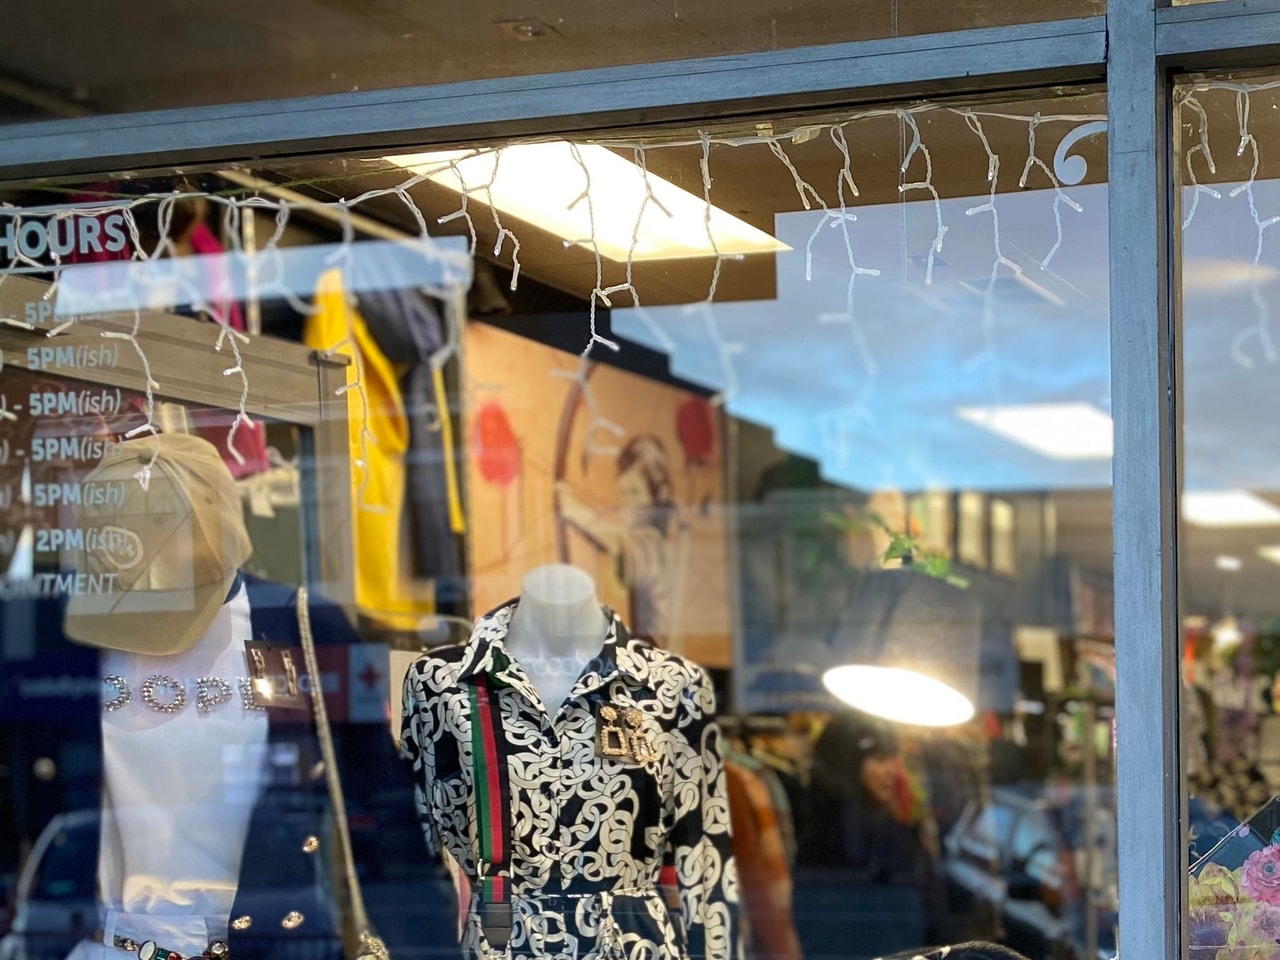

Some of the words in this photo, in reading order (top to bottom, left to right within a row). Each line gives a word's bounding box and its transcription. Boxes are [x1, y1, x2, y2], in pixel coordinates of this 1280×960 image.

[0, 214, 126, 259] HOURS
[27, 343, 119, 370] 5PM(ish)
[29, 388, 121, 416] 5PM(ish)
[34, 481, 126, 508] 5PM(ish)
